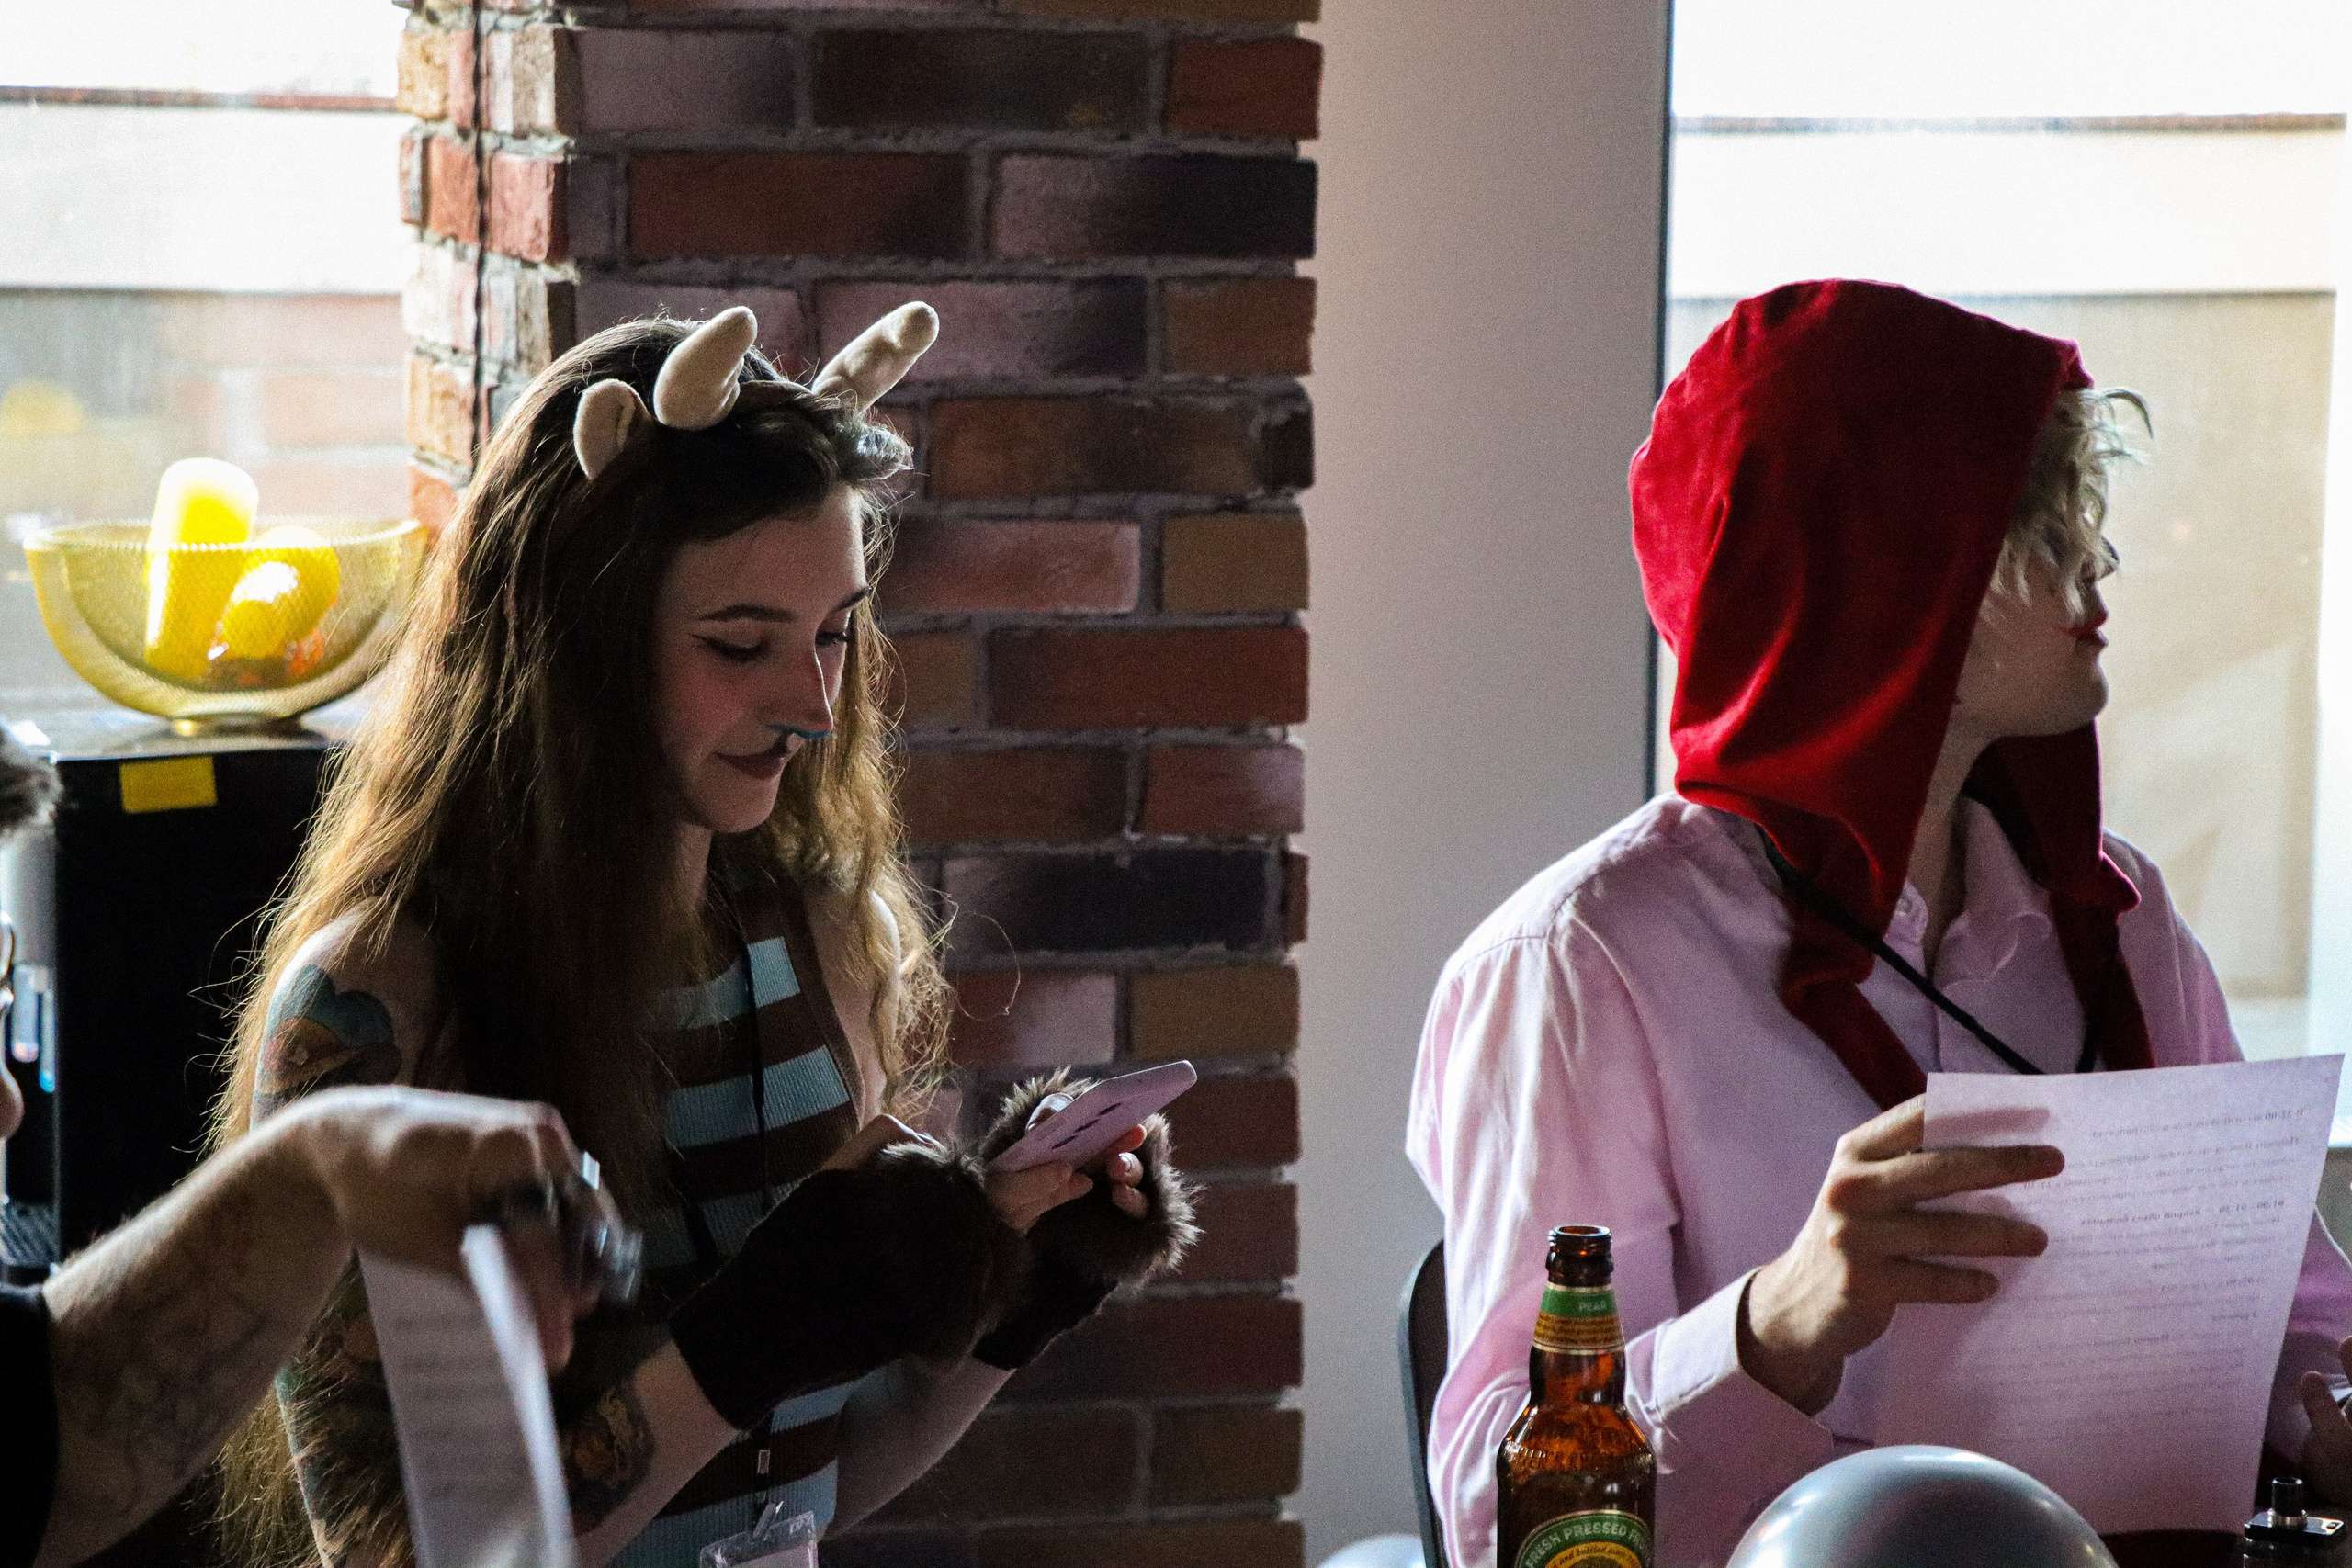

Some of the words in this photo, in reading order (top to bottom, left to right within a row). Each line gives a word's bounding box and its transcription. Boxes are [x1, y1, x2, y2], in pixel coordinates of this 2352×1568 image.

[1578, 1300, 1607, 1312] PEAR
[1525, 1531, 1562, 1568] FRESH
[1563, 1522, 1628, 1540] PRESSED
